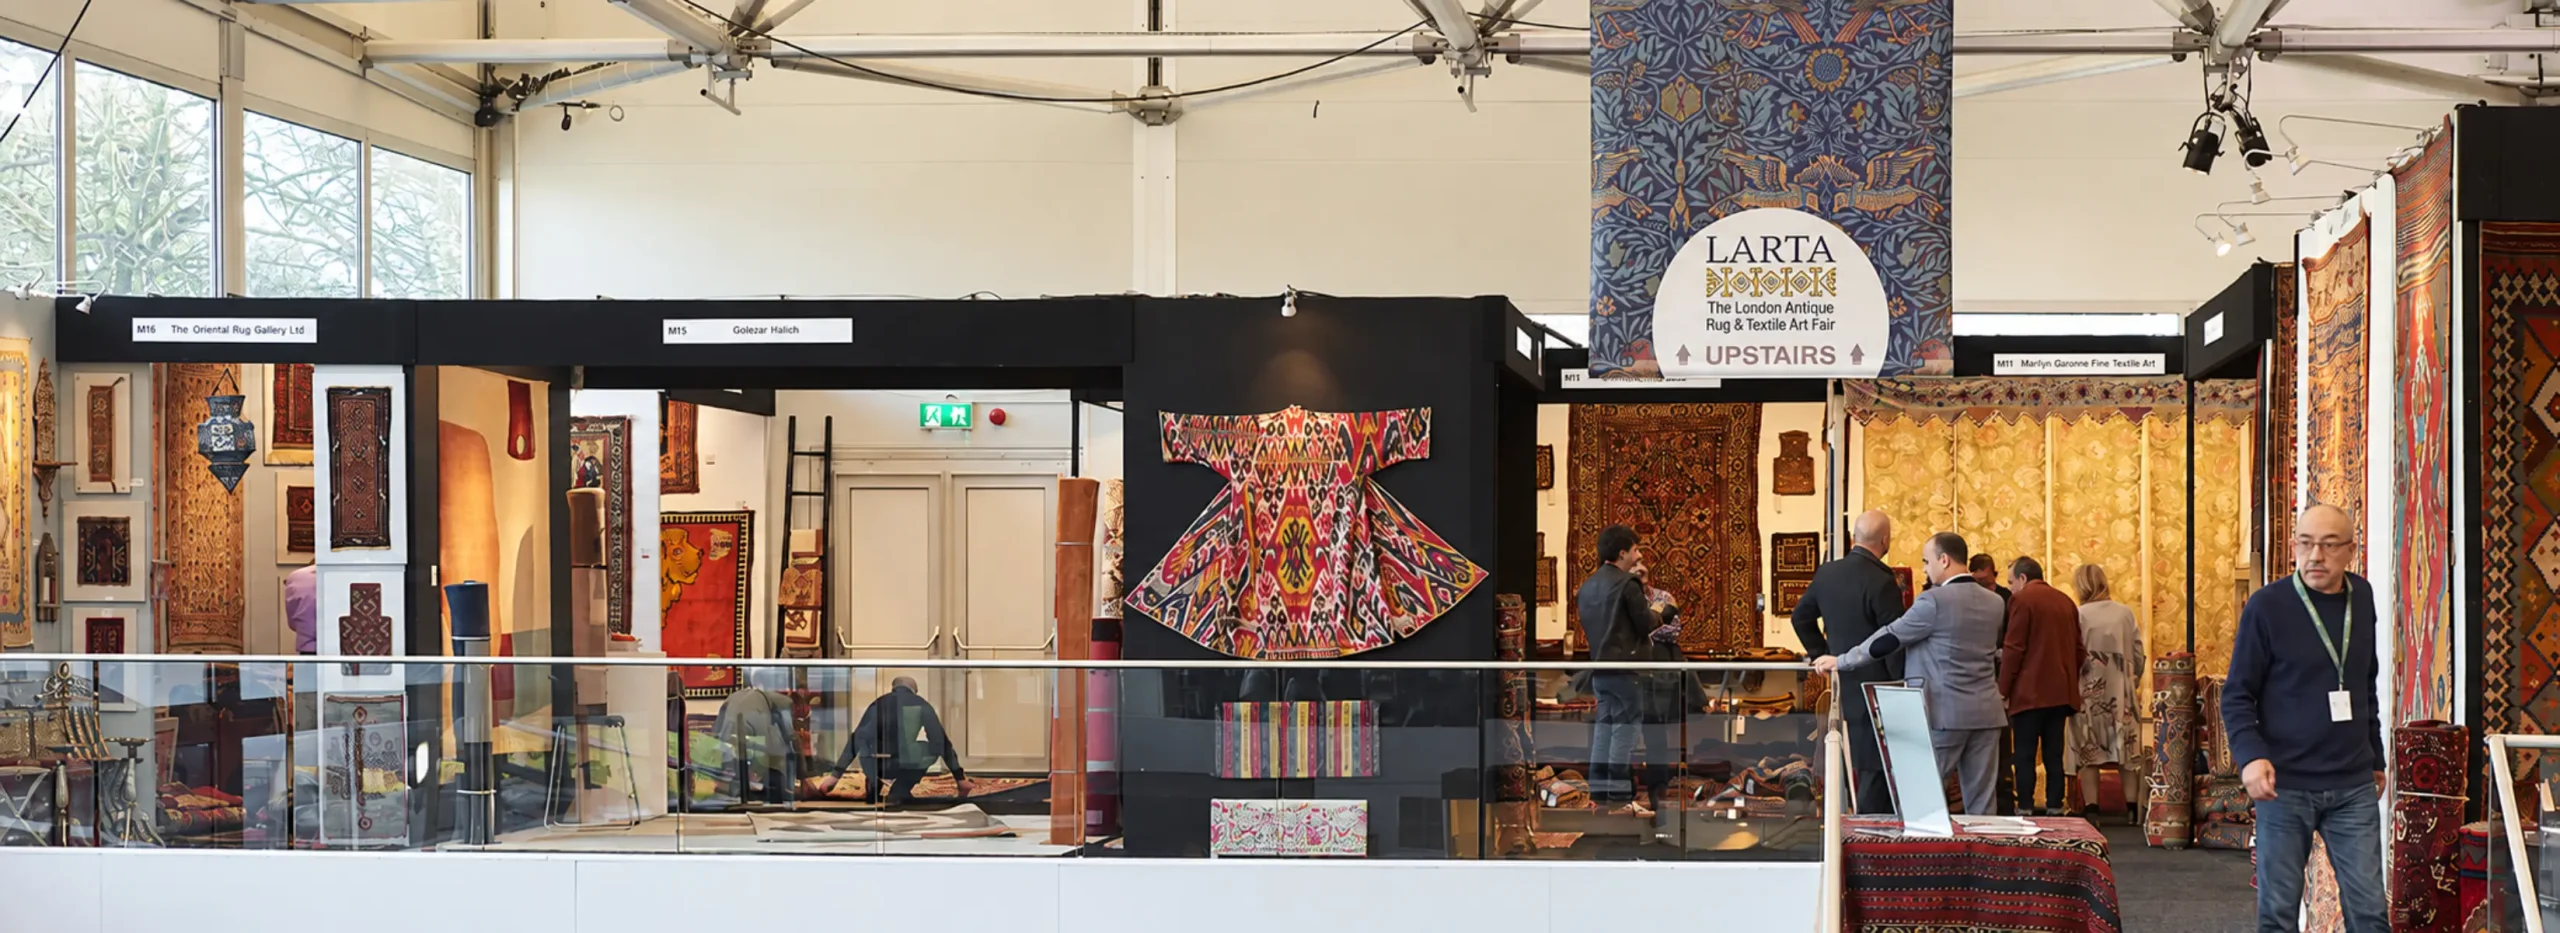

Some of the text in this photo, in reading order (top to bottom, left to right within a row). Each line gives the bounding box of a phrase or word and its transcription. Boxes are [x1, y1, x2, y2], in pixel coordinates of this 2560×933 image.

[1706, 235, 1836, 263] LARTA
[1707, 301, 1834, 317] The London Antique
[137, 325, 305, 337] M16 The Oriental Rug Gallery Ltd
[668, 325, 800, 336] M15 Golezar Halich
[1706, 318, 1836, 334] Rug & Textile Art Fair
[1706, 345, 1836, 365] UPSTAIRS
[1997, 359, 2156, 370] M11 Marilyn Garonne Fine Textile Art
